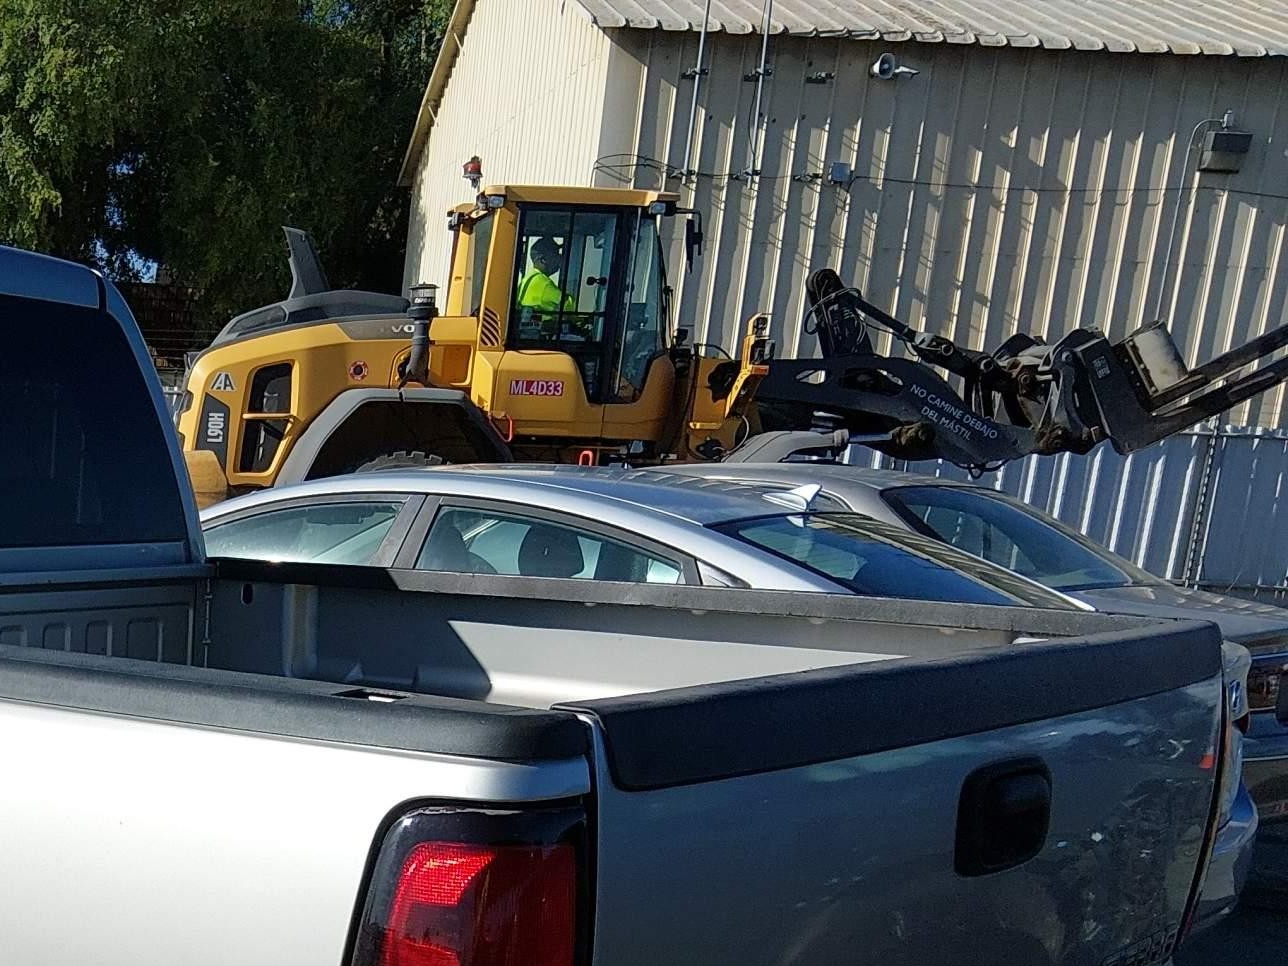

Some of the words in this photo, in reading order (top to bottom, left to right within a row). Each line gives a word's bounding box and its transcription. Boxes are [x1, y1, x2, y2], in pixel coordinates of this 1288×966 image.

[510, 380, 564, 396] ML4D33
[909, 383, 928, 399] NO
[927, 393, 964, 420] CAMINE
[962, 413, 999, 440] DEBAJO
[920, 405, 939, 423] DEL
[206, 412, 225, 443] L90H
